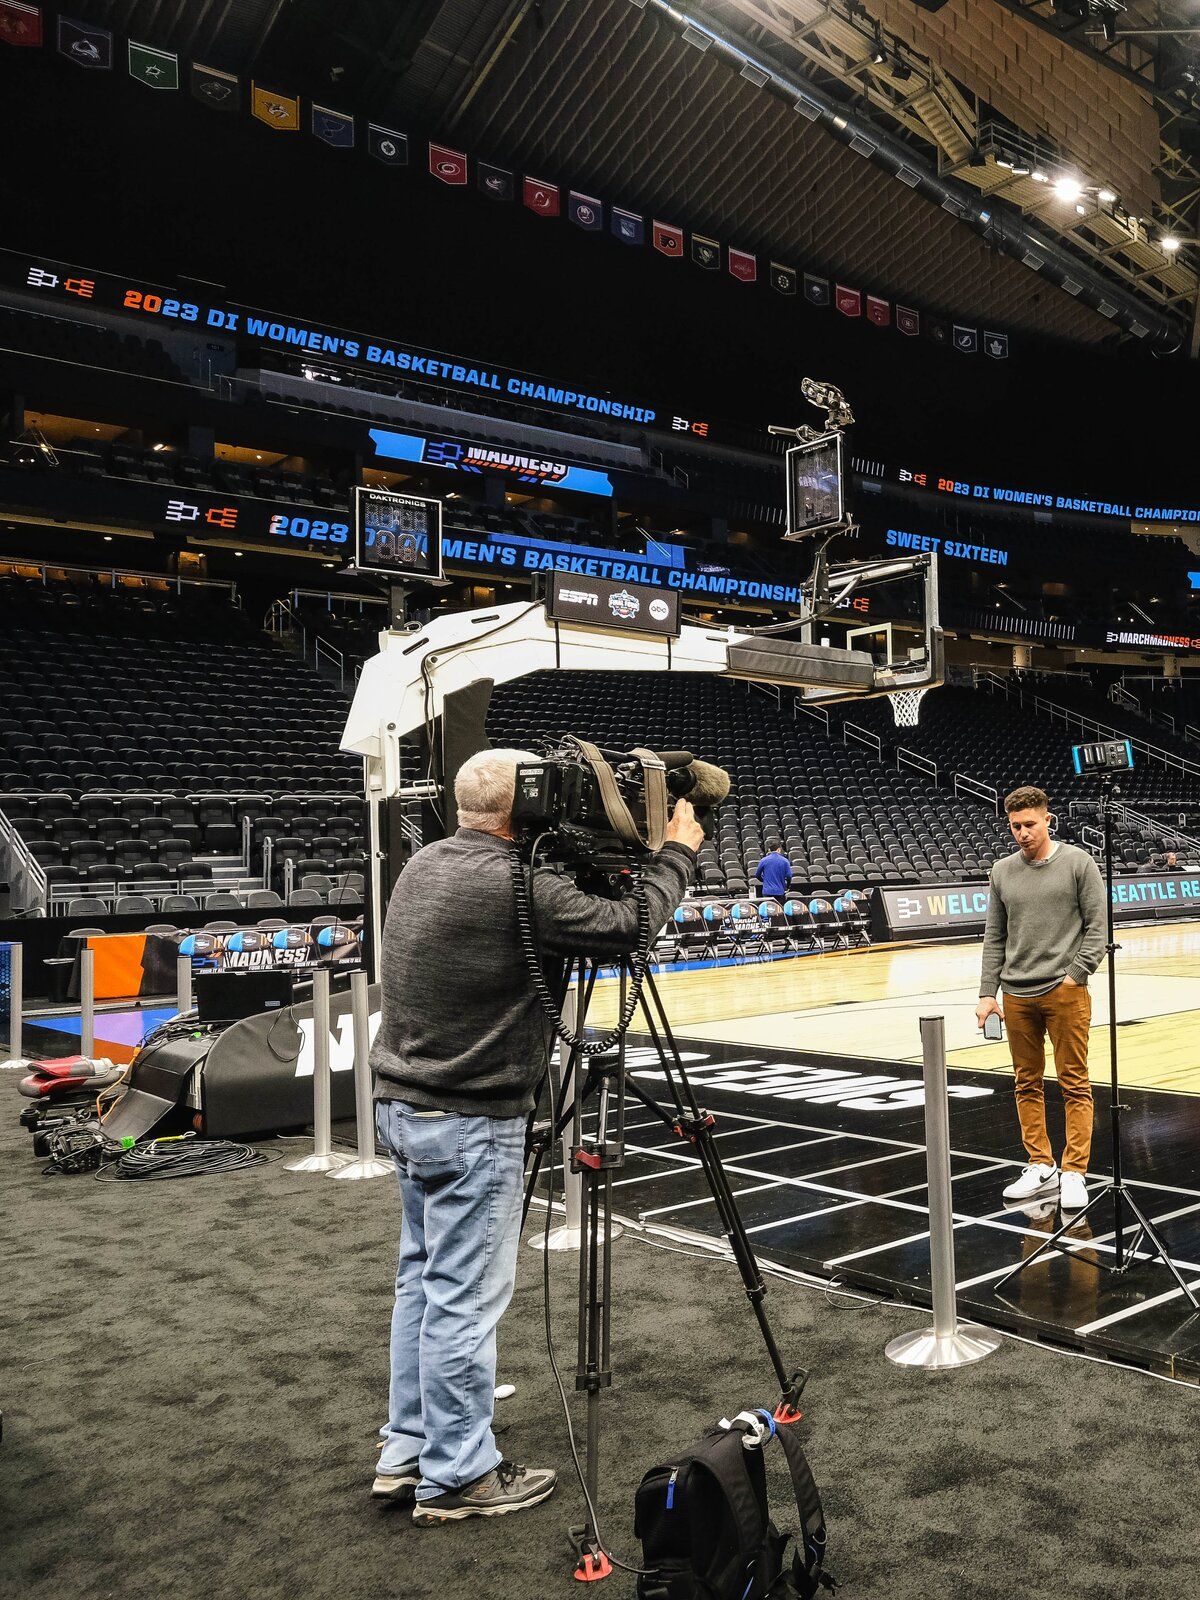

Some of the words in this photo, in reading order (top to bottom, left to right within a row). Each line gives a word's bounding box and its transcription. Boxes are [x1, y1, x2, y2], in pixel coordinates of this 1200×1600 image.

[123, 289, 199, 322] 2023
[207, 308, 239, 331] DI
[246, 317, 360, 359] WOMEN'S
[366, 345, 502, 391] BASKETBALL
[506, 378, 657, 424] CHAMPIONSHIP
[369, 493, 426, 508] DAKTRONICS
[938, 478, 970, 496] 2023
[973, 485, 990, 499] DI
[993, 487, 1053, 507] WOMEN'S
[1056, 496, 1132, 519] BASKETBALL
[269, 514, 350, 543] 2023
[523, 550, 661, 586] BASKETBALL
[667, 570, 802, 604] CHAMPIONSH
[886, 529, 940, 552] SWEET
[943, 540, 1008, 566] SIXTEEN
[558, 588, 599, 606] ESPN
[927, 892, 990, 916] WELC
[1107, 881, 1177, 903] SEATTLE
[223, 948, 308, 968] MADNESS
